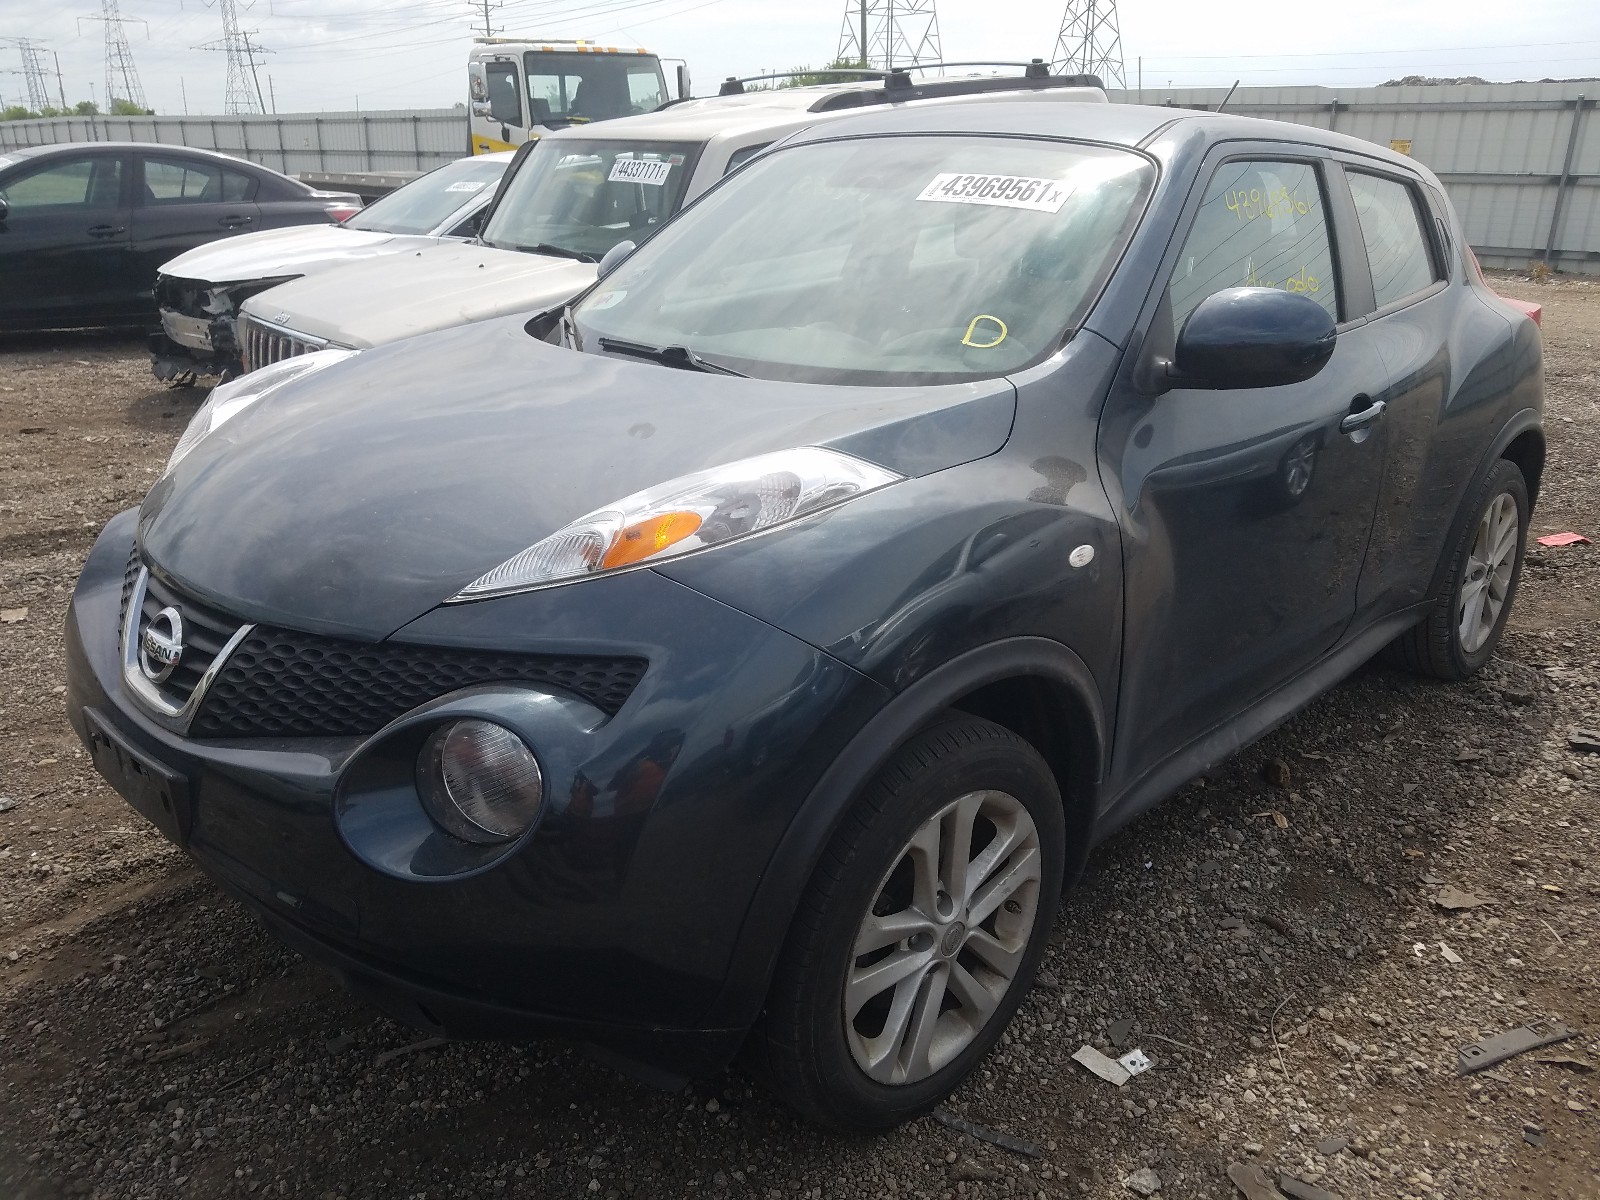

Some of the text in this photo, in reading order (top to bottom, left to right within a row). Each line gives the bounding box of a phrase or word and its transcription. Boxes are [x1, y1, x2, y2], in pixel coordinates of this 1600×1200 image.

[617, 161, 663, 179] 44337171
[940, 175, 1054, 203] 43969561
[960, 314, 1008, 348] D
